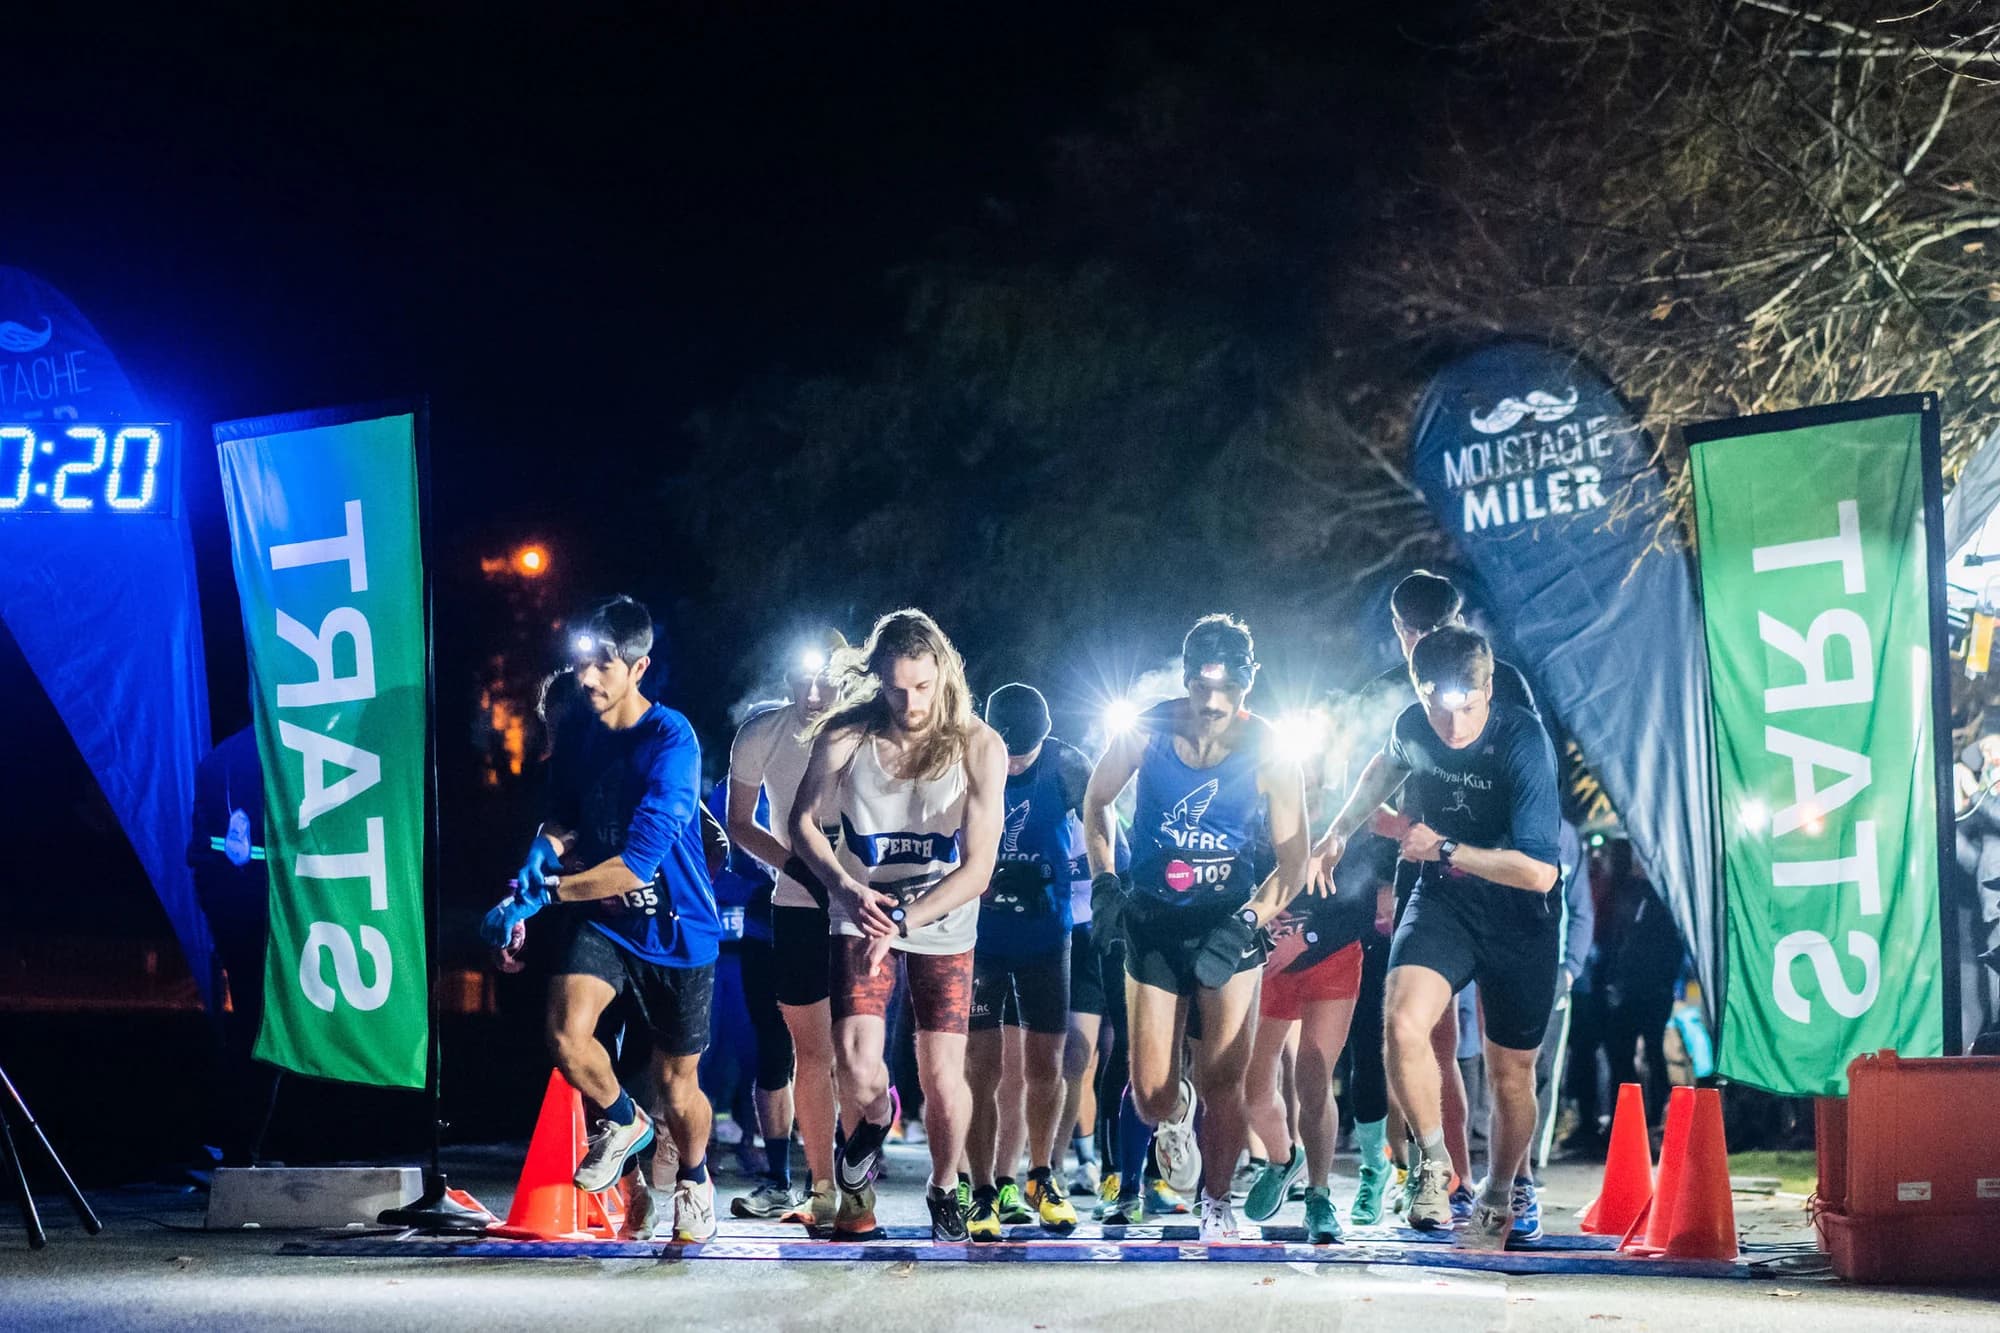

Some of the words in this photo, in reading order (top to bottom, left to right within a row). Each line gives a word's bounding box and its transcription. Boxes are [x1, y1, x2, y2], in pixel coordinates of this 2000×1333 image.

[1444, 416, 1613, 489] MOUSTACHE
[1464, 466, 1606, 532] MILER
[876, 837, 934, 863] PERTH
[1173, 830, 1228, 850] VFAC
[1192, 864, 1232, 884] 109
